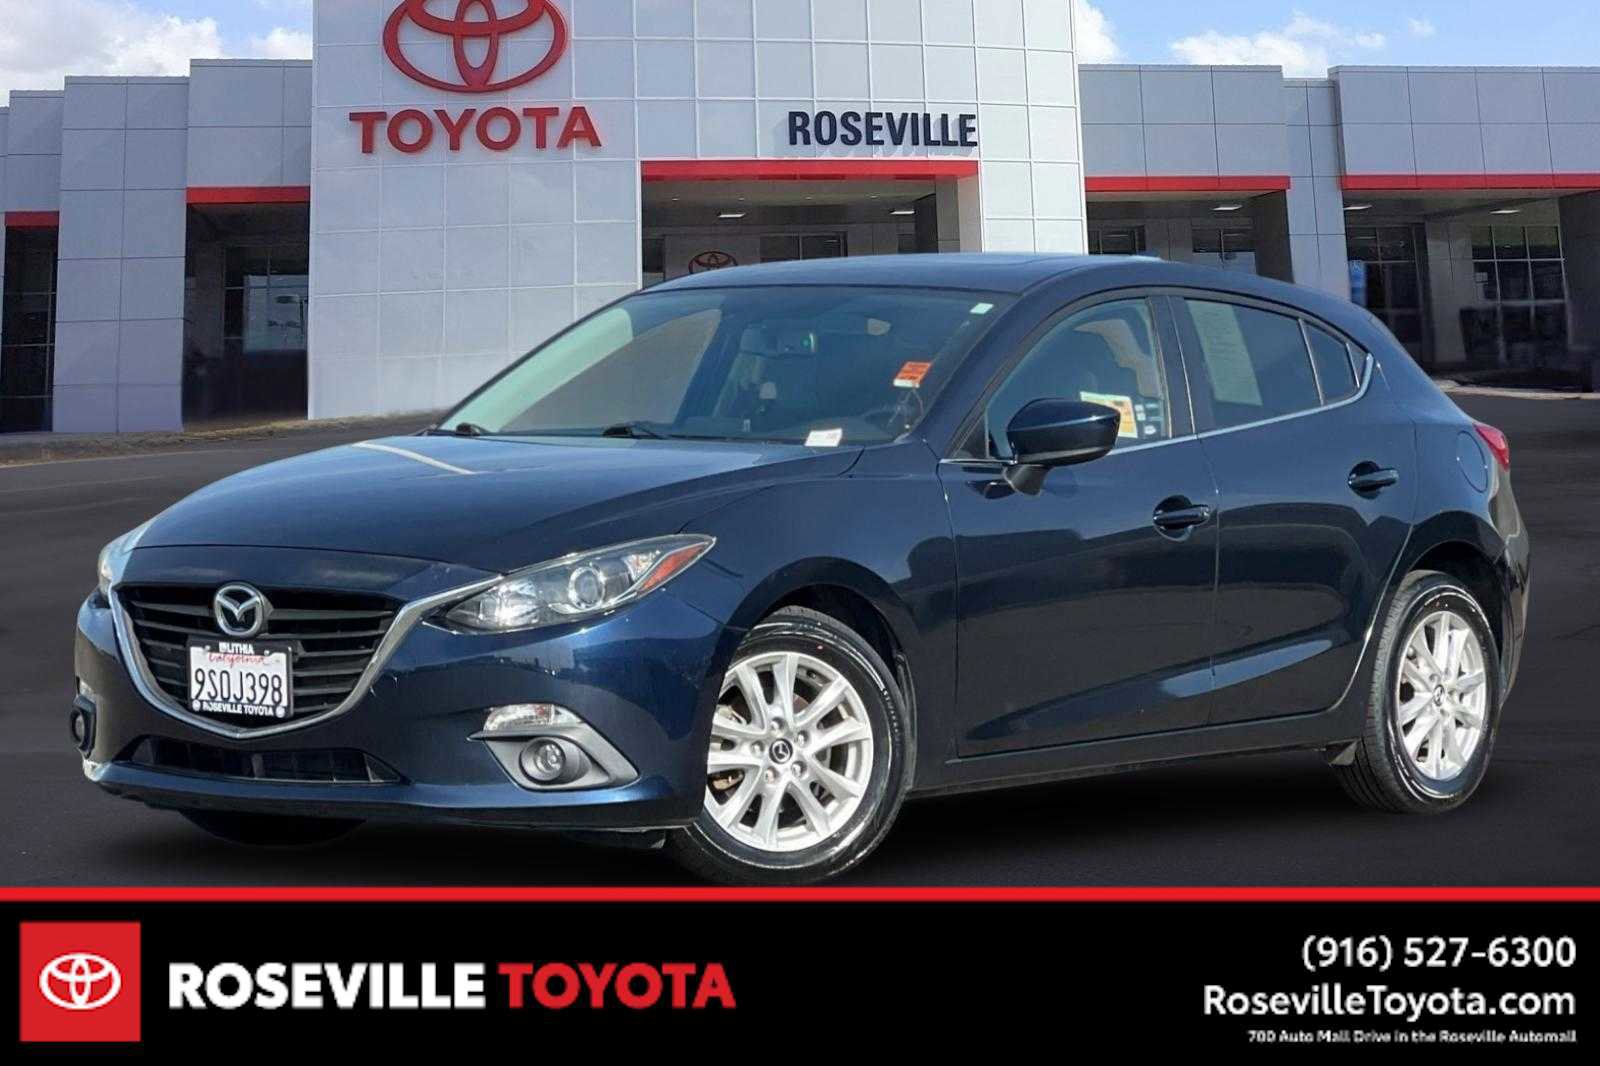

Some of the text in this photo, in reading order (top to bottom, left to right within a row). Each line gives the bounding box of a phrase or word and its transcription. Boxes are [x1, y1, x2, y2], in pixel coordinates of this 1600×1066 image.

[349, 106, 602, 154] TOYOTA
[788, 110, 978, 147] ROSEVILLE
[202, 701, 274, 716] ROSEVILLE TOYOTA
